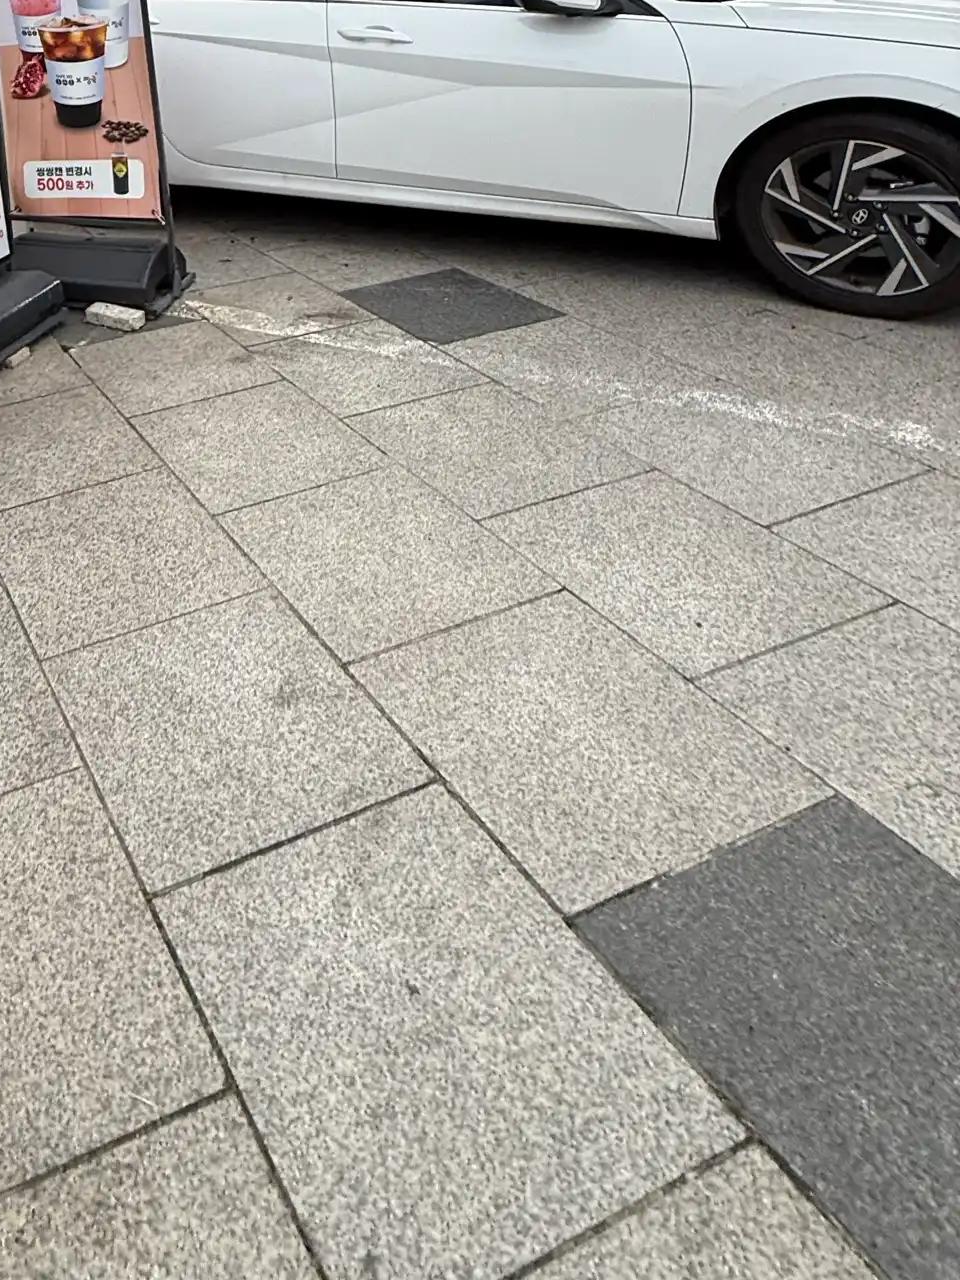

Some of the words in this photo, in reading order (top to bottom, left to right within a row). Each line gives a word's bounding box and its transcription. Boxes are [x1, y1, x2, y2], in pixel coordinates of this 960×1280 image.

[65, 166, 93, 177] 변경시
[37, 177, 74, 192] 500원
[76, 181, 94, 191] 추가
